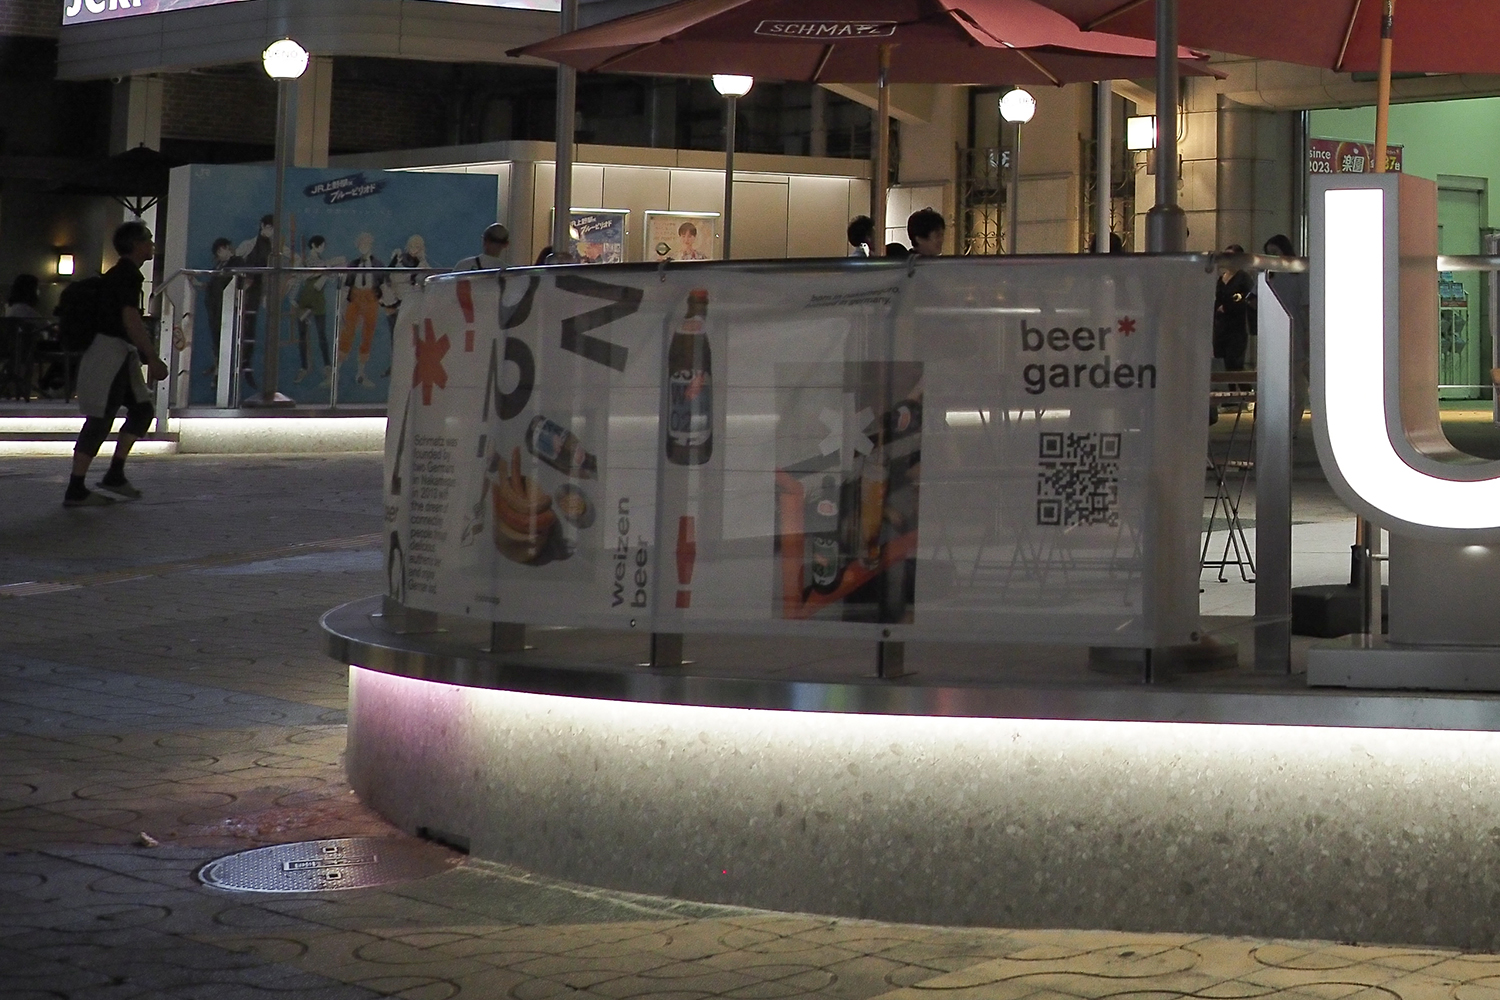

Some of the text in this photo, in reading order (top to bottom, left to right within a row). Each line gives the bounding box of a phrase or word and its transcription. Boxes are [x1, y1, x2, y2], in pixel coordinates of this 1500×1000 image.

[1309, 146, 1331, 160] since
[1022, 354, 1157, 395] garden
[610, 497, 630, 608] weizen
[630, 534, 648, 608] beer
